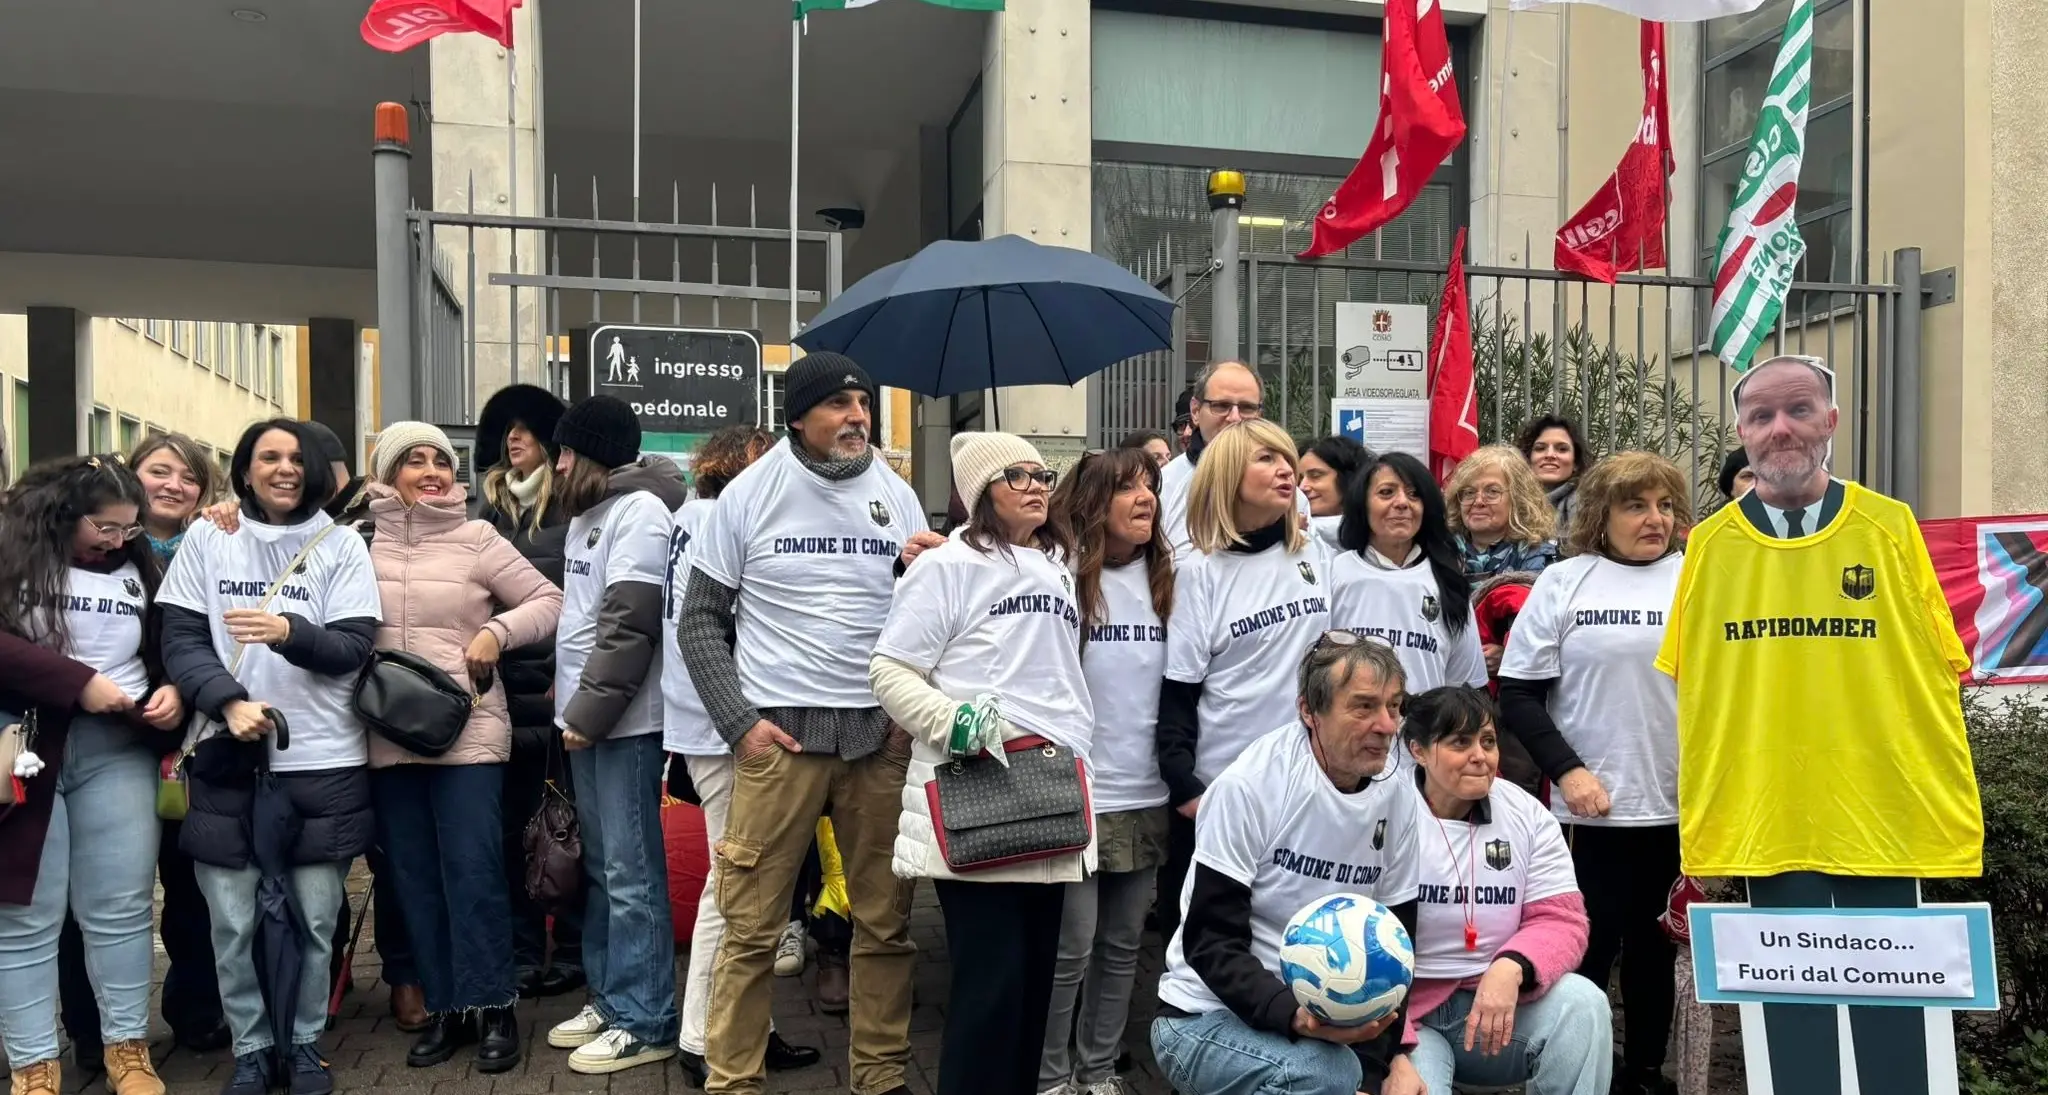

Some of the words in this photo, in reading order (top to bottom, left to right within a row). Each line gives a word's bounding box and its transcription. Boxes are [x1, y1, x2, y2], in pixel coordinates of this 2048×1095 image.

[655, 357, 743, 379] ingresso
[1344, 388, 1362, 397] AREA
[1362, 388, 1420, 398] VIDEOSORVEGLIATA
[631, 400, 728, 418] pedonale
[774, 537, 837, 554] COMUNE
[842, 538, 857, 553] DI
[862, 538, 897, 557] COMO
[572, 559, 590, 576] COMO
[219, 579, 266, 597] COMUNE
[97, 597, 113, 614] DI
[116, 600, 137, 616] COM
[989, 594, 1050, 616] COMUNE
[1229, 605, 1286, 639] COMUNE
[1287, 600, 1301, 619] DI
[1302, 597, 1328, 614] COM
[1576, 609, 1641, 626] COMUNE
[1647, 610, 1663, 625] DI
[1089, 624, 1129, 642] MUNE
[1133, 624, 1146, 642] DI
[1149, 625, 1168, 642] COM
[1724, 616, 1877, 641] RAPIBOMBER
[1406, 631, 1438, 653] COMO
[1273, 848, 1335, 880] COMUNE
[1335, 862, 1350, 884] DI
[1352, 865, 1383, 885] COMO
[1454, 885, 1470, 904] DI
[1474, 885, 1516, 905] COMO
[1760, 931, 1791, 947] Un
[1796, 932, 1915, 950] Sindaco...
[1738, 963, 1795, 981] Fuori
[1801, 967, 1838, 983] dal
[1843, 967, 1945, 984] Comune
